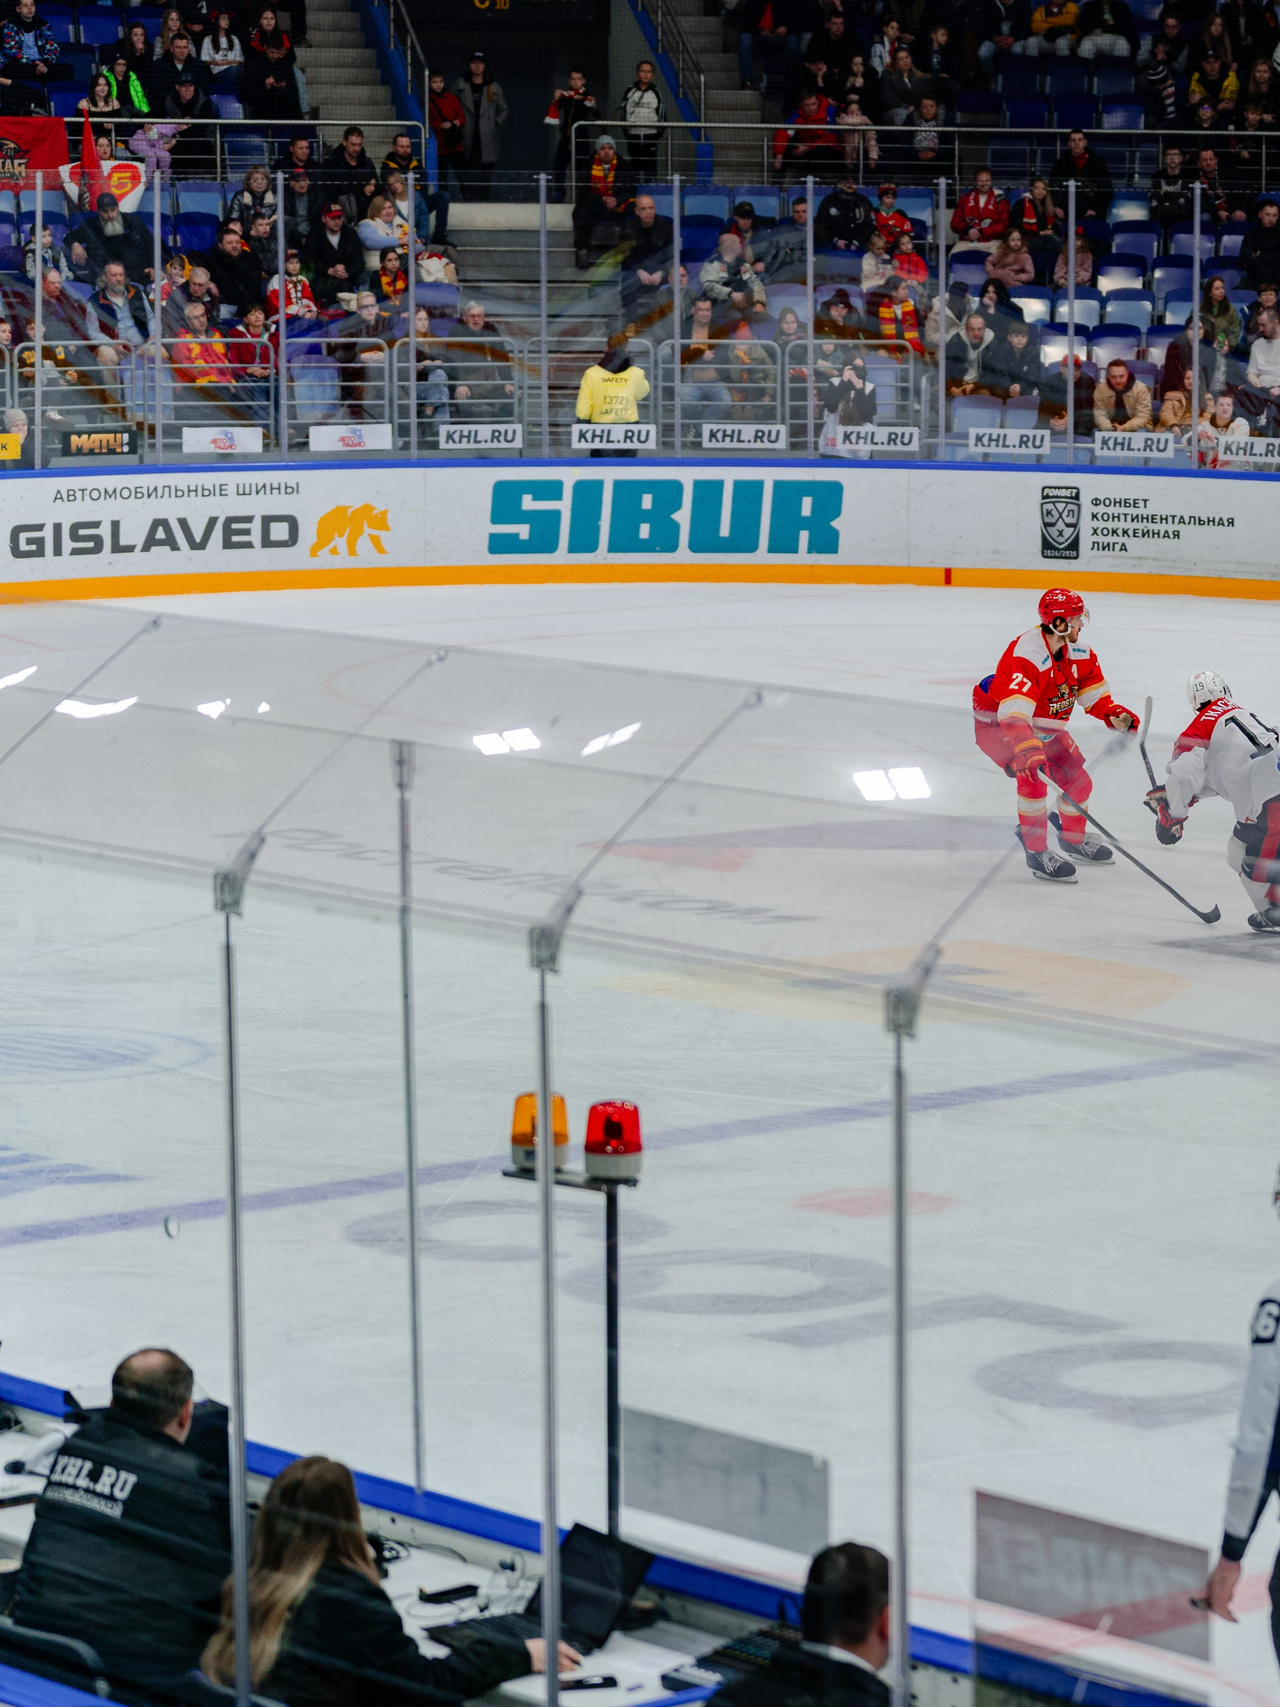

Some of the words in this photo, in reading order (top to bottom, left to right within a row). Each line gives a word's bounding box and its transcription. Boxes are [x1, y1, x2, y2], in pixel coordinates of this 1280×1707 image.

[110, 172, 132, 194] 5
[445, 429, 516, 445] KHL.RU
[577, 429, 651, 444] KHL.RU
[708, 429, 781, 444] KHL.RU
[842, 430, 914, 447] KHL.RU
[974, 432, 1045, 449] KHL.RU
[1101, 435, 1169, 453] KHL.RU
[53, 483, 229, 503] АВТОМОБИЛЬНЫЕ
[236, 481, 300, 496] ШИНЫ
[1043, 488, 1078, 498] FONBET
[1091, 497, 1150, 509] ФОНБЕТ
[487, 479, 844, 554] SIBUR
[1091, 512, 1235, 528] КОНТИНЕНТАЛЬНАЯ
[9, 514, 299, 559] GISLAVED
[1091, 526, 1181, 540] ХОККЕЙНАЯ
[1043, 550, 1077, 558] 2024/2025
[1090, 541, 1128, 553] ЛИГА
[1008, 672, 1033, 693] 27
[1194, 681, 1205, 693] 19
[50, 1454, 138, 1501] KHL.RU
